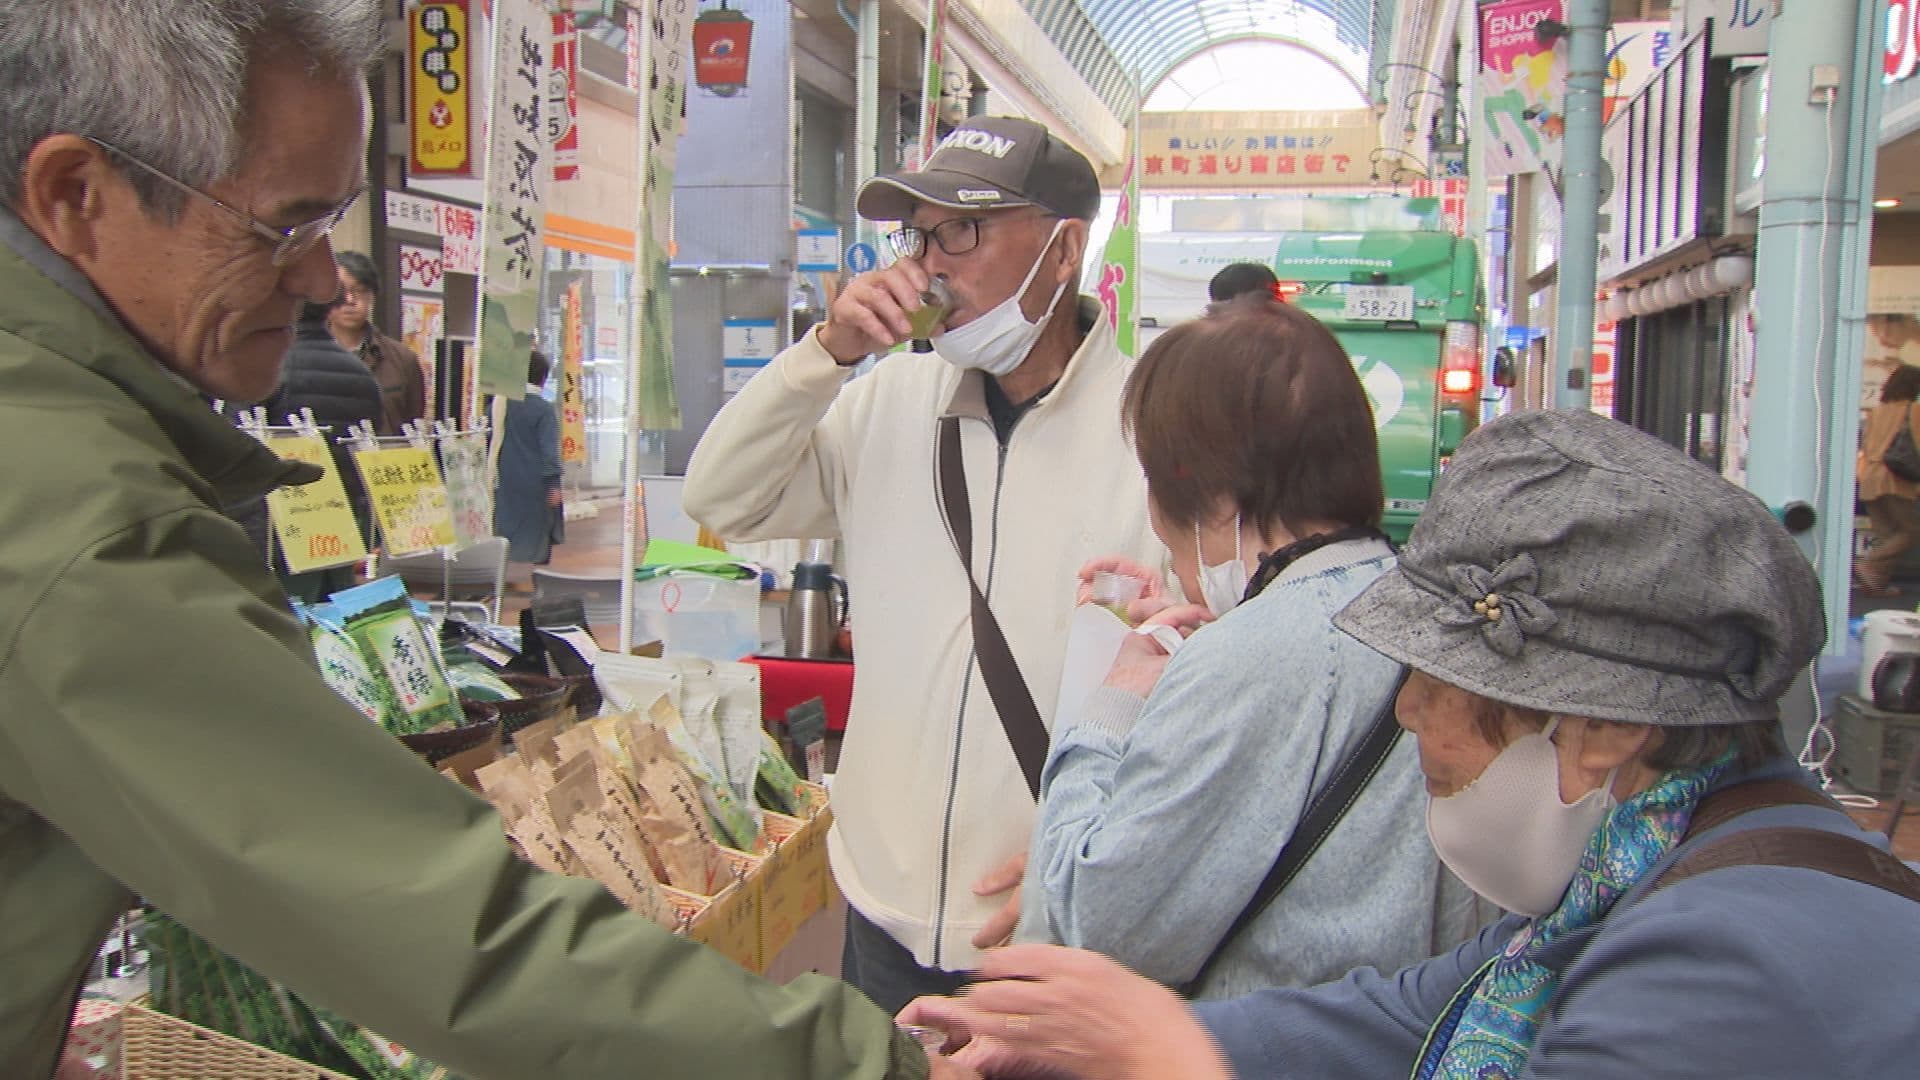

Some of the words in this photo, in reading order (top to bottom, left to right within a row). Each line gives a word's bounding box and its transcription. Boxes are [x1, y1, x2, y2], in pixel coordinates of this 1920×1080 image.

[1490, 8, 1552, 35] ENJOY
[1488, 31, 1535, 49] SHOPPI
[1283, 255, 1393, 268] environment
[1359, 300, 1407, 318] 58-21
